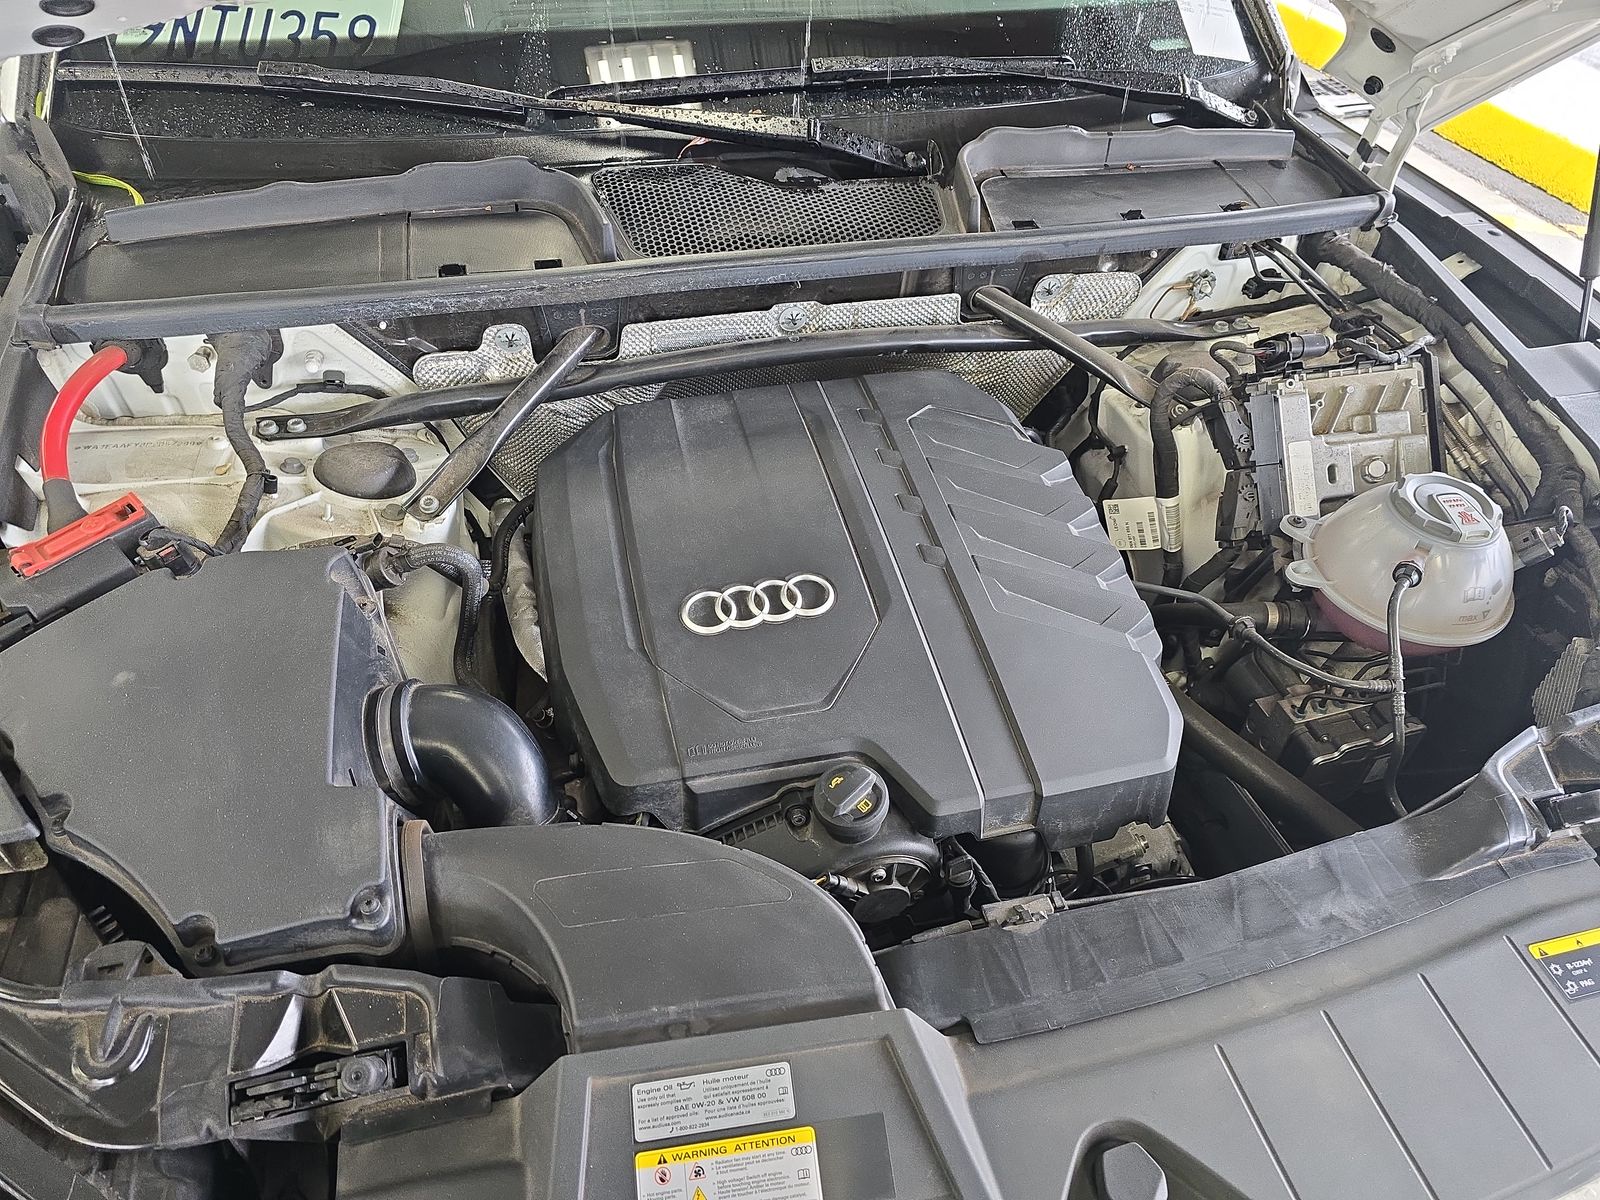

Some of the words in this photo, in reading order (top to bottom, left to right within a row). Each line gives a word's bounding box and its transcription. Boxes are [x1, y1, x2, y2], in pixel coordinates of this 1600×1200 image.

[1579, 979, 1595, 987] PAG
[723, 1074, 749, 1082] moteur
[637, 1086, 661, 1096] Engine
[638, 1102, 659, 1110] expressly
[661, 1098, 681, 1106] complies
[674, 1104, 689, 1112] SAE
[692, 1100, 716, 1109] 0W-20
[672, 1145, 727, 1162] WARNING
[734, 1135, 796, 1152] ATTENTION
